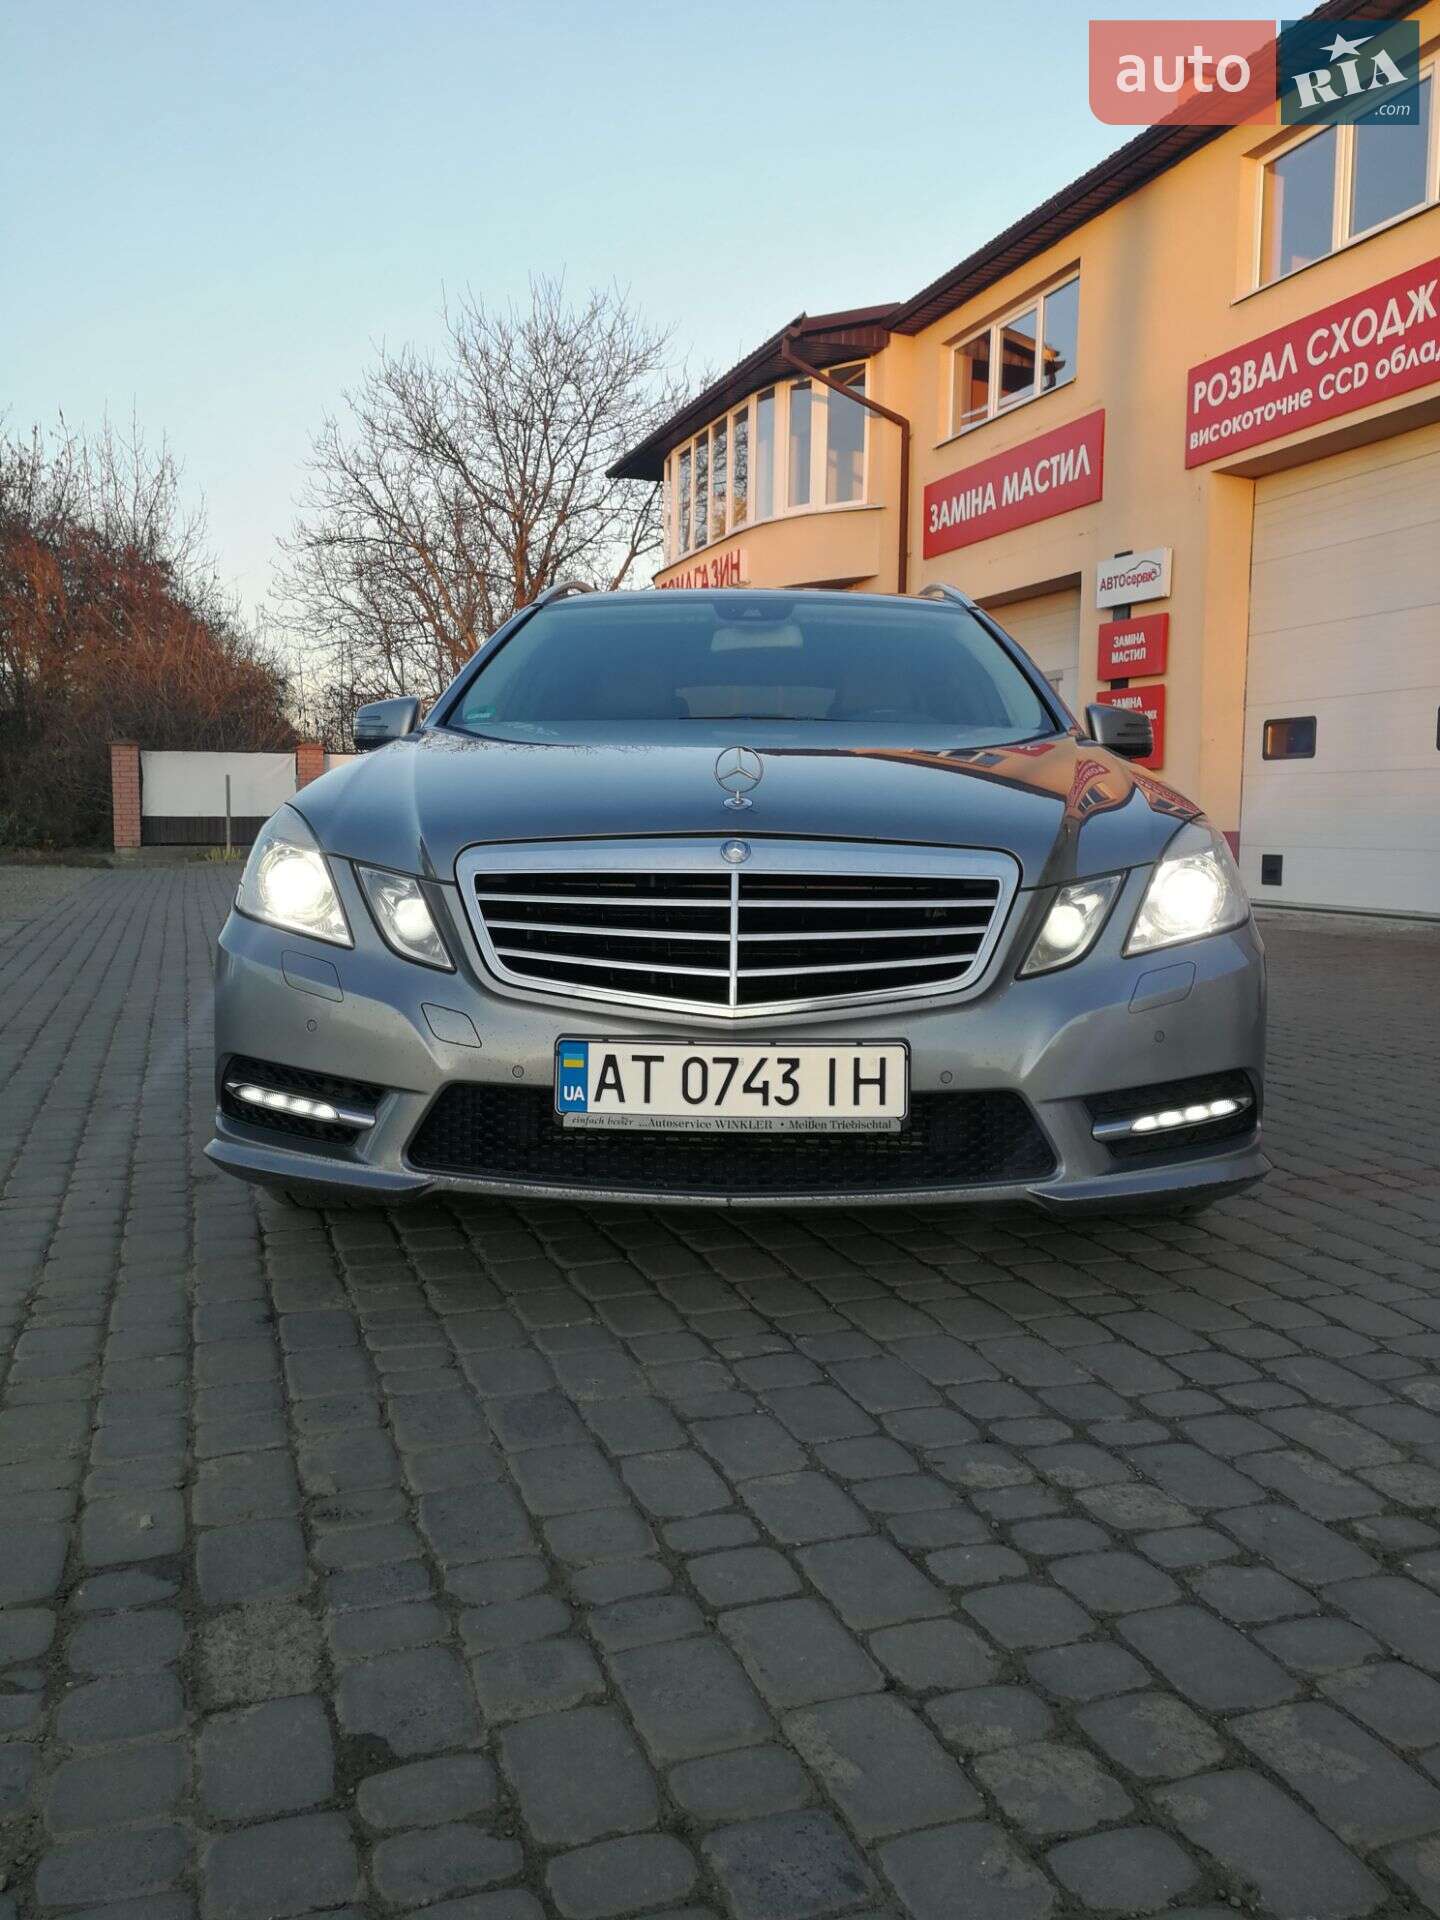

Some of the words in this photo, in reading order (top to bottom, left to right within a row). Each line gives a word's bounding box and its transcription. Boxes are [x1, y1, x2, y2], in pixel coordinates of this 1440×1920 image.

[1192, 343, 1298, 414] РОЗВАЛ
[1306, 279, 1439, 367] СХОДЖ
[1190, 387, 1313, 450] високоточне
[1318, 362, 1369, 401] CCD
[929, 482, 997, 534] ЗАМІНА
[1001, 444, 1092, 507] МАСТИЛ
[1111, 647, 1146, 664] МАСТИЛ
[1112, 631, 1146, 648] ЗАМІНА
[563, 1086, 585, 1101] UA
[594, 1054, 664, 1104] AT
[681, 1056, 801, 1106] 0743
[828, 1057, 887, 1106] IH
[715, 1119, 773, 1130] WINKLER
[829, 1119, 892, 1130] Triebischtal
